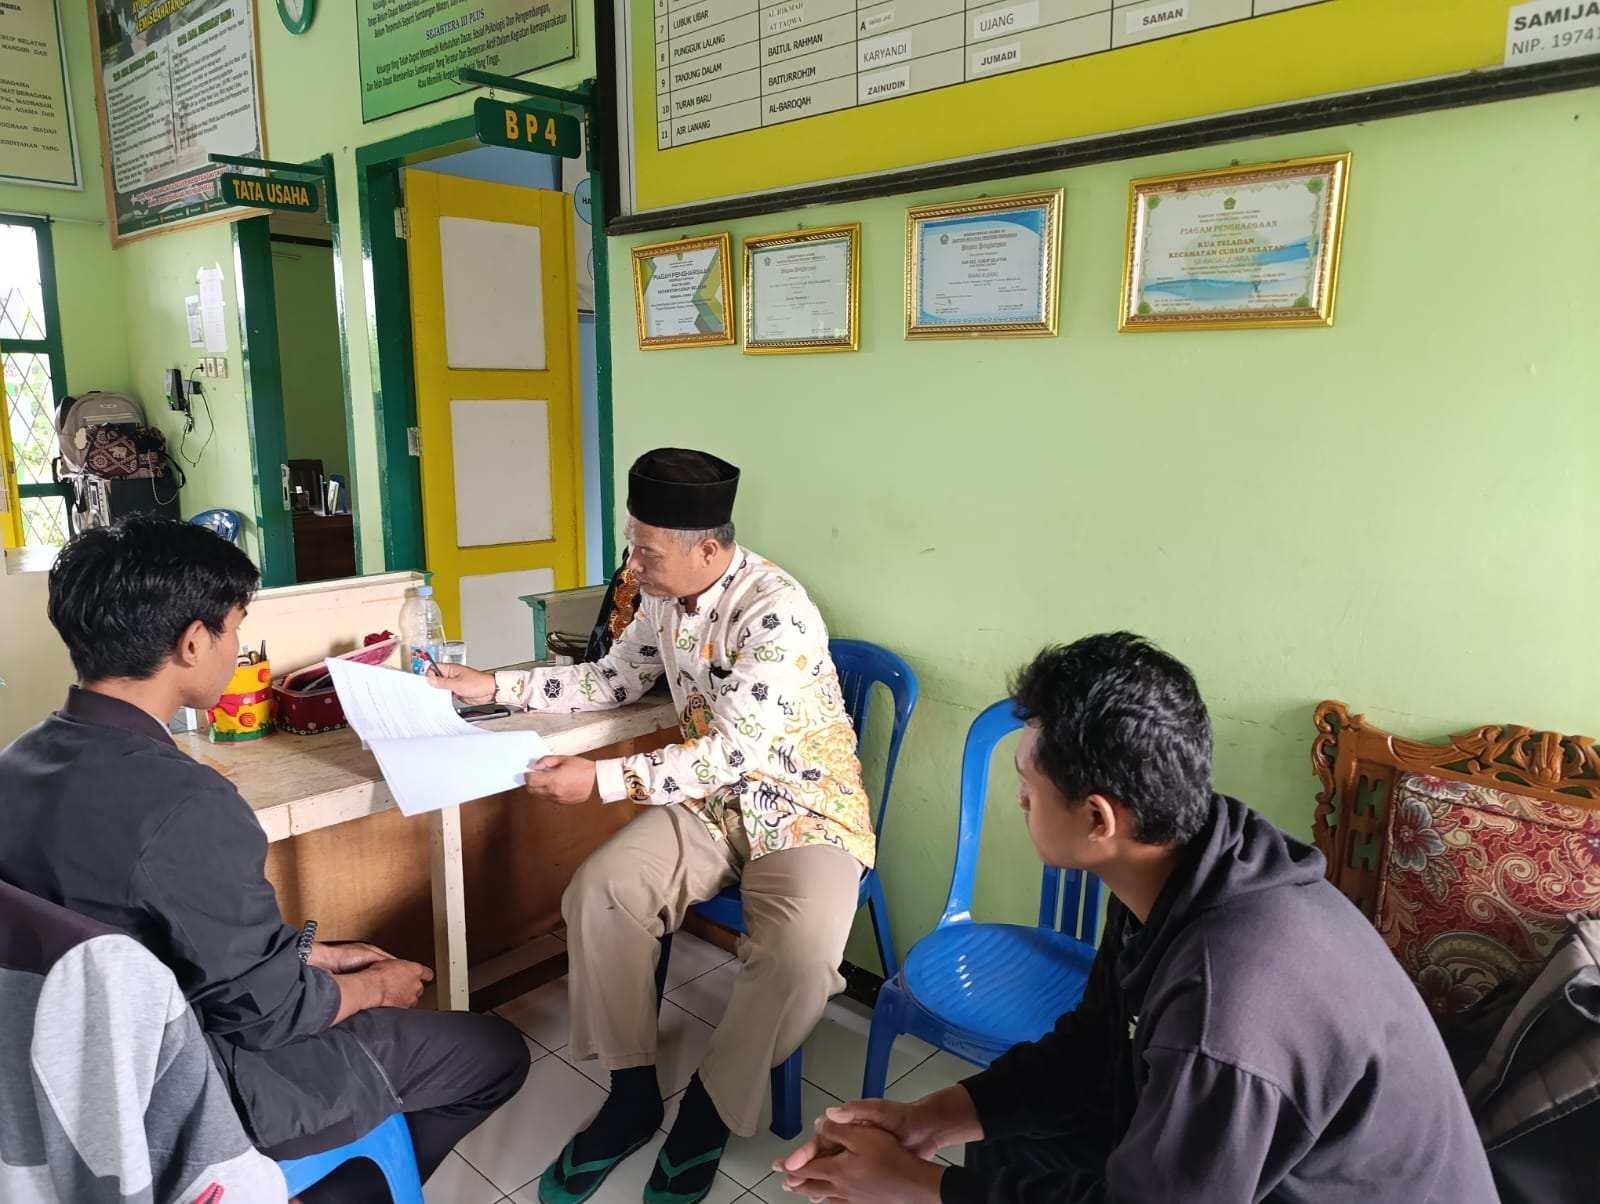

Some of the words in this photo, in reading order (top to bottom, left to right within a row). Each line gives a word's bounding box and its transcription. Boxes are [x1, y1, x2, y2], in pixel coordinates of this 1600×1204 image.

[674, 17, 692, 30] LUBUK
[979, 13, 1015, 32] UJANG
[1142, 8, 1184, 26] SAMAN
[1514, 1, 1600, 31] SAMIJA
[673, 42, 702, 57] PUNGGUK
[702, 33, 726, 49] LALANG
[768, 45, 793, 57] BAITUL
[793, 33, 823, 51] RAHMAN
[863, 43, 908, 64] KARYANDI
[1511, 37, 1545, 56] NIP.
[980, 50, 1017, 67] JUMADI
[675, 68, 701, 84] TANJUNG
[702, 62, 723, 77] DALAM
[768, 66, 816, 87] BAITURROHIM
[867, 80, 906, 96] ZAINUDIN
[662, 105, 670, 115] 10
[675, 96, 695, 111] TURAN
[696, 93, 712, 105] BARU
[661, 130, 669, 140] 11
[676, 126, 687, 137] AIR
[687, 120, 711, 133] LANANG
[232, 179, 265, 202] TATA
[266, 183, 310, 207] USAHA
